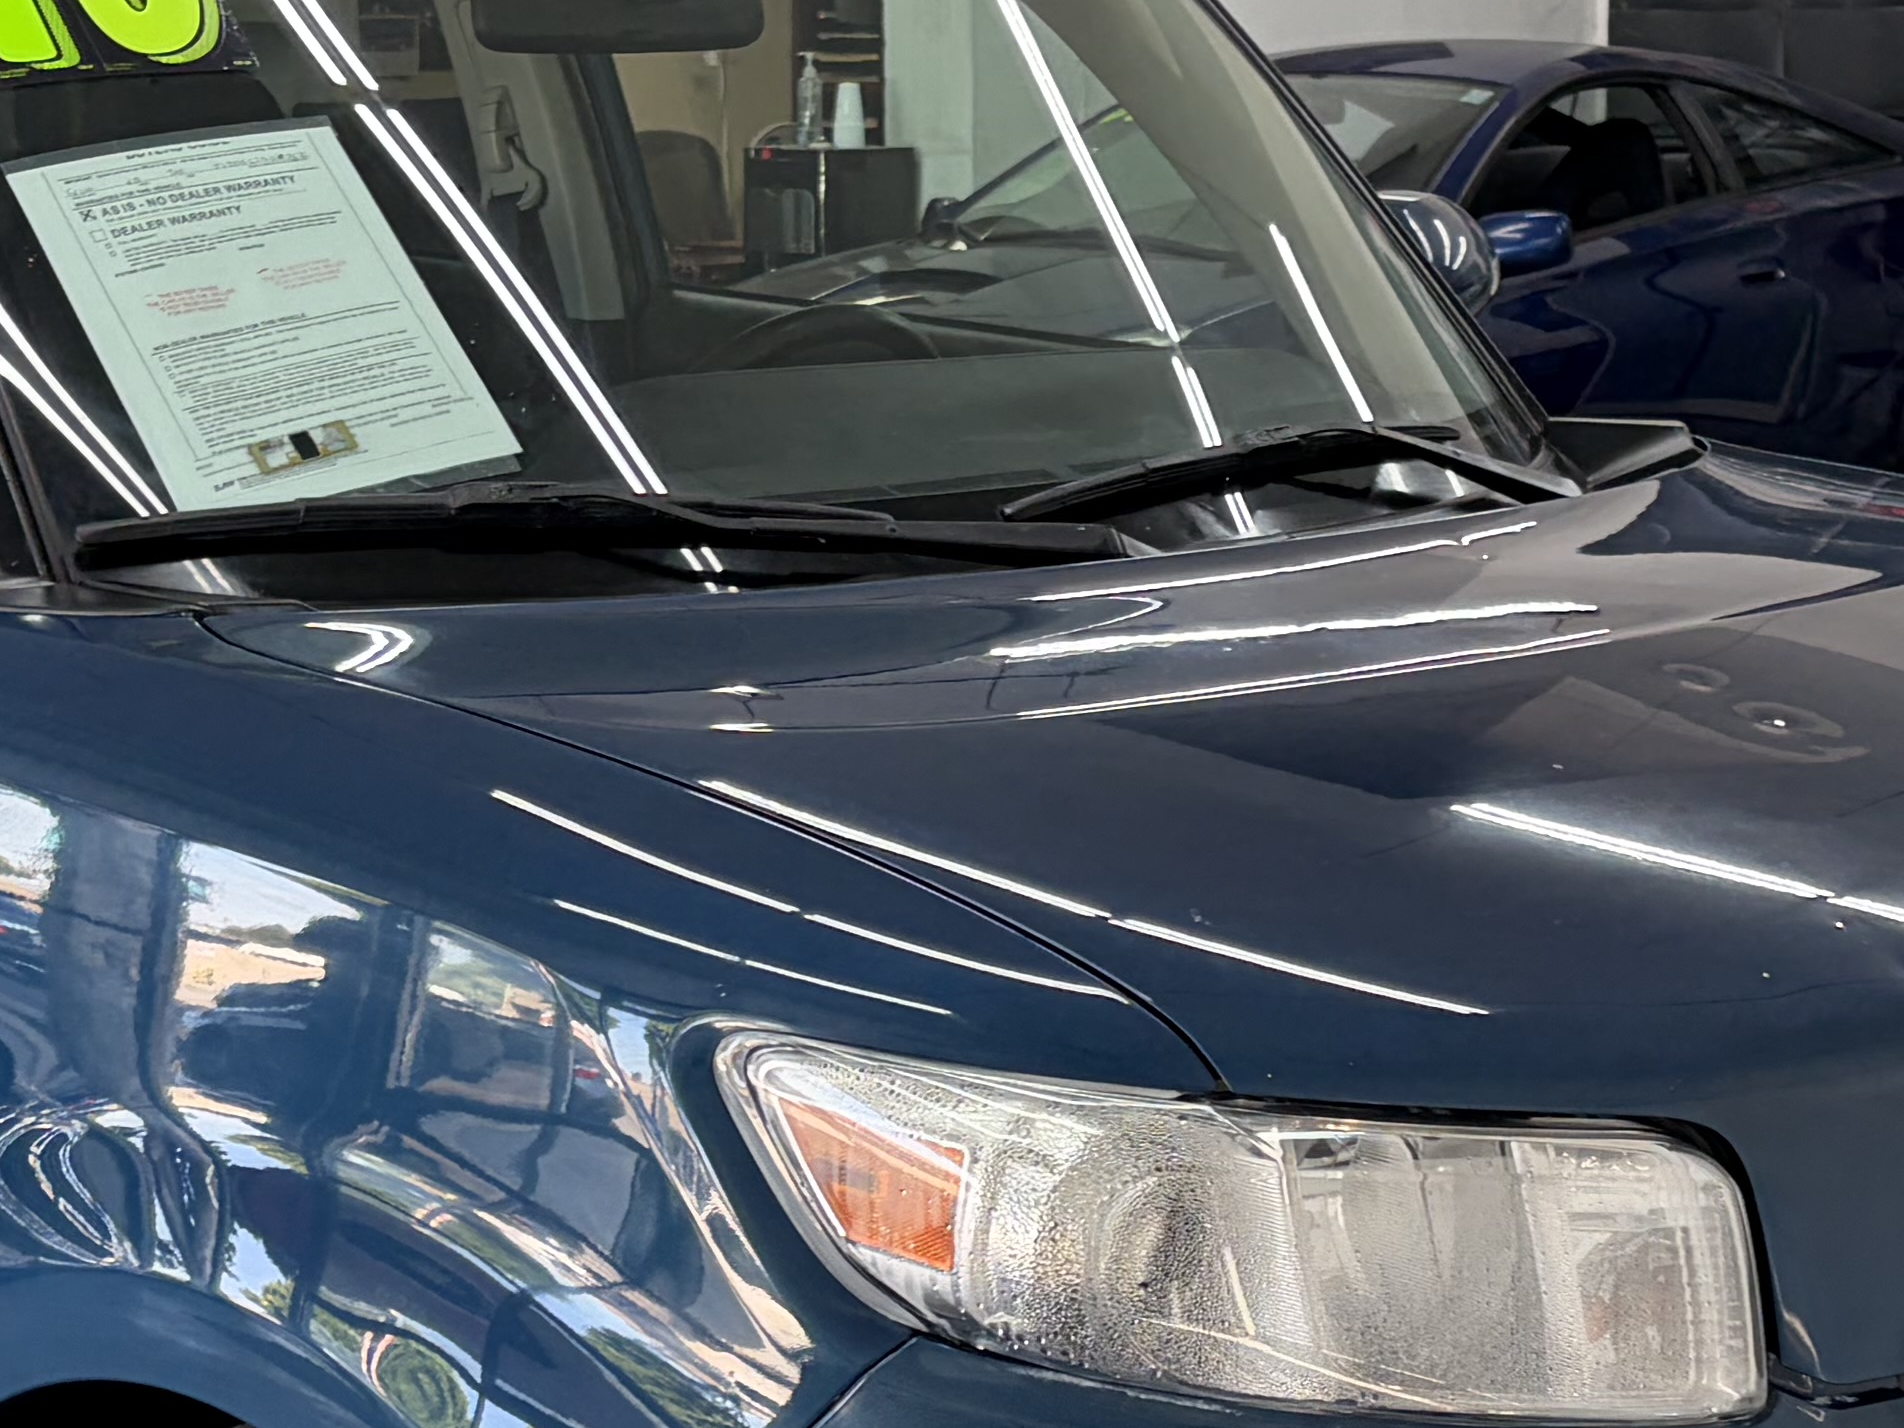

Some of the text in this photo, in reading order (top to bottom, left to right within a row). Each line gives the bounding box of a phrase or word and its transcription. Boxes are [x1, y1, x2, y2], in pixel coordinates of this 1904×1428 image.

[101, 204, 121, 218] AS
[121, 202, 137, 213] IS
[145, 195, 167, 208] NO
[168, 186, 222, 204] DEALER
[223, 174, 296, 194] WARRANTY
[110, 204, 242, 239] DEALER WARRANTY
